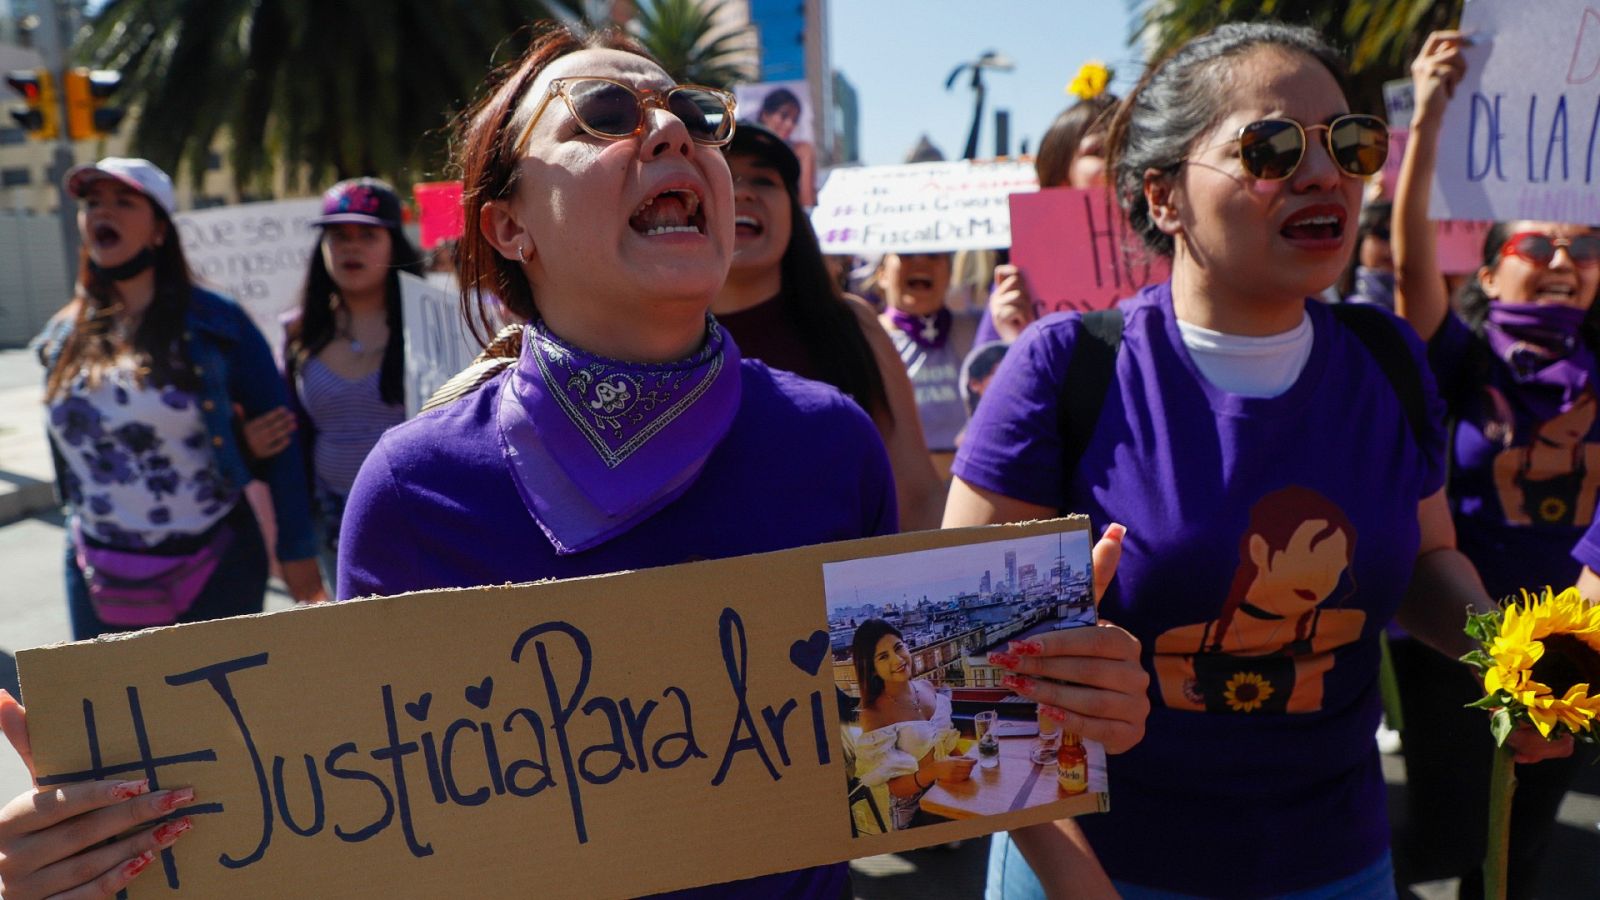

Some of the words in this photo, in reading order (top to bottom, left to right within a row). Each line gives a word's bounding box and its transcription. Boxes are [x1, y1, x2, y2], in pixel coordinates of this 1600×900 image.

[1467, 91, 1508, 182] DE
[1528, 93, 1569, 183] LA
[711, 607, 830, 786] Ari
